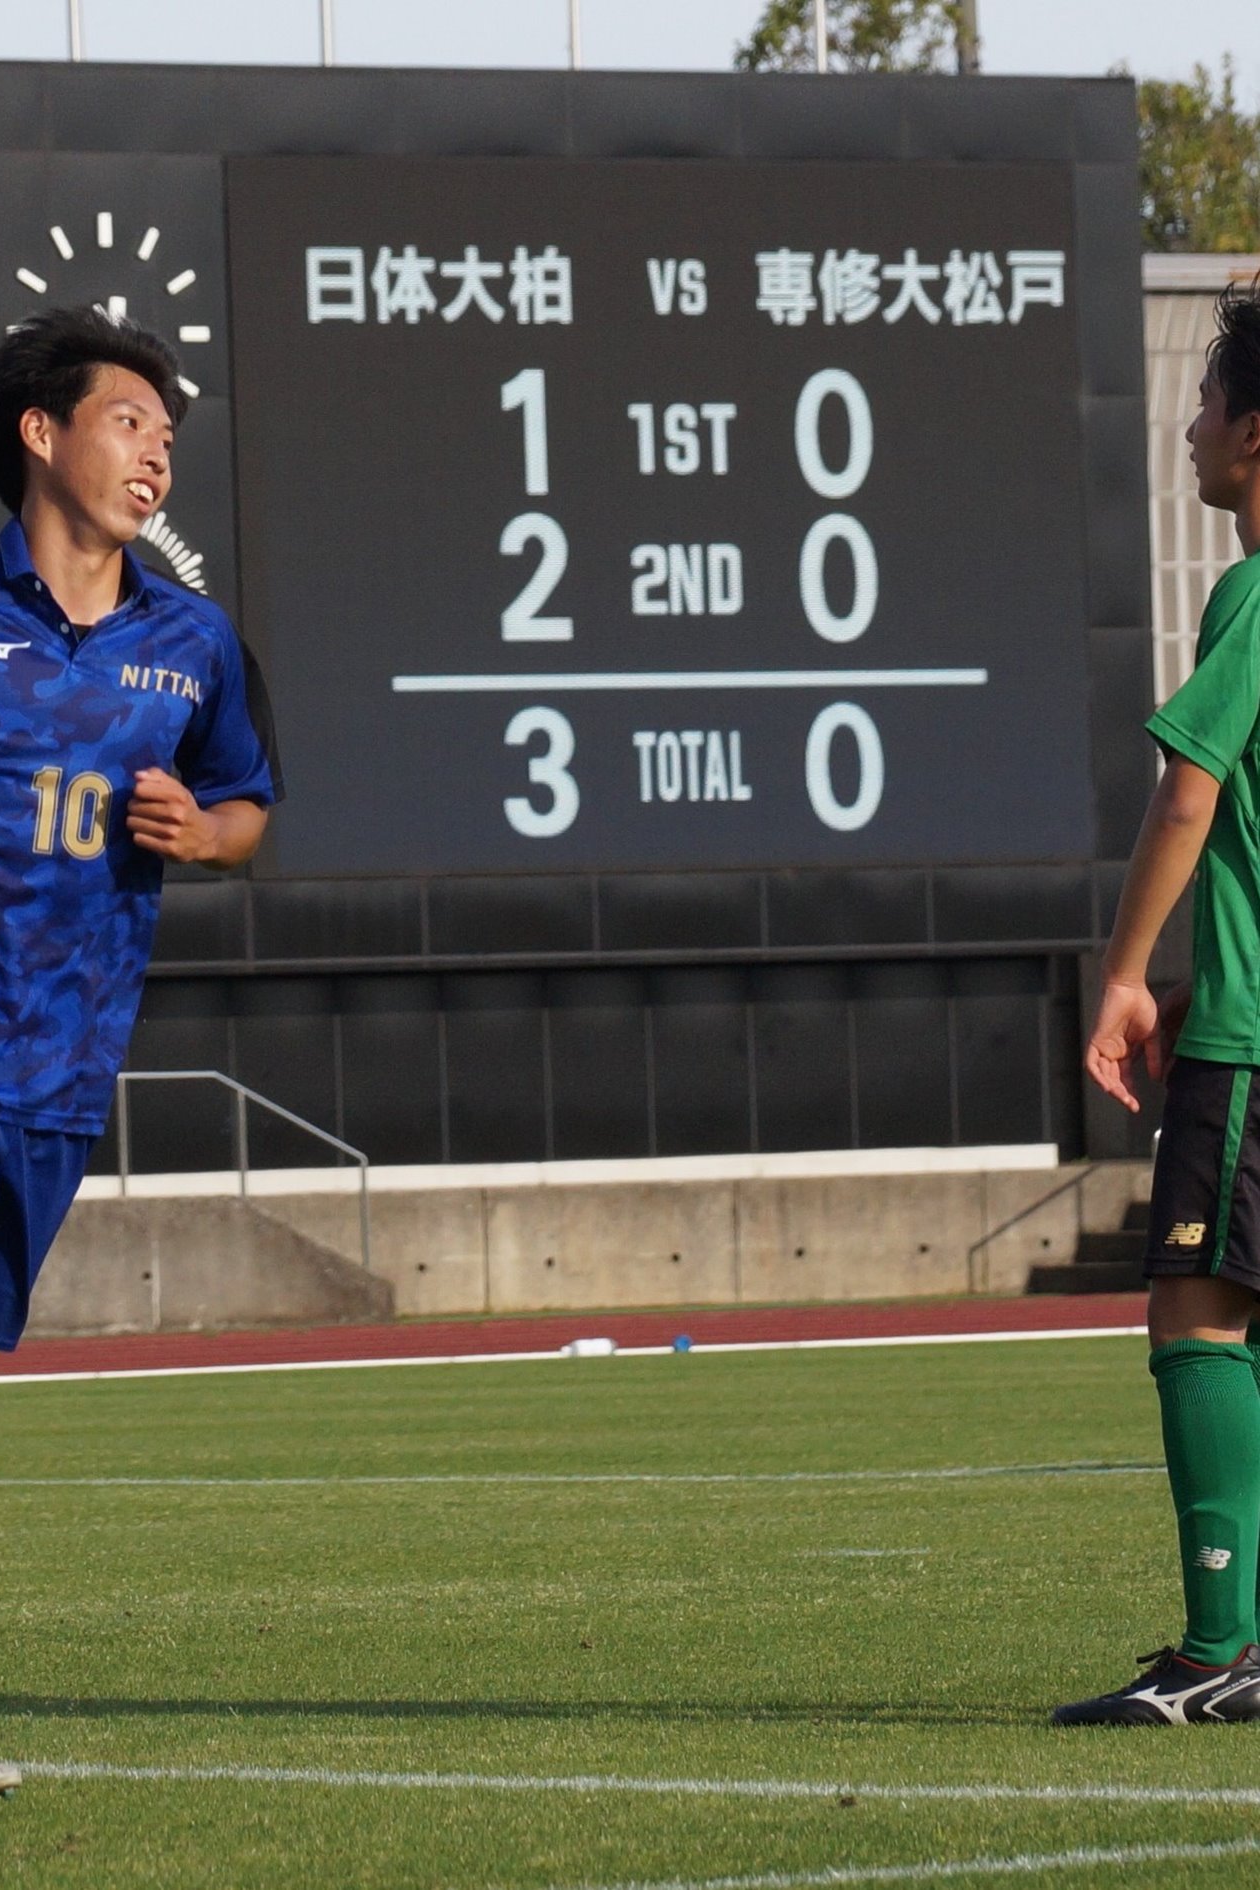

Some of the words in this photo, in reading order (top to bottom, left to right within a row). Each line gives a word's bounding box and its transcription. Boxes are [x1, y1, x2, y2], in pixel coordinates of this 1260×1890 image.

[305, 245, 573, 325] 日体大柏
[646, 258, 708, 316] VS
[755, 247, 1066, 326] 専修大松戸
[500, 368, 549, 496] 1
[627, 403, 737, 475] 1ST
[794, 368, 873, 499] 0
[499, 512, 574, 642] 2
[630, 543, 743, 616] 2ND
[799, 513, 878, 643] 0
[31, 766, 114, 860] 10
[503, 706, 580, 838] 3
[632, 731, 752, 803] TOTAL
[805, 702, 884, 832] 0
